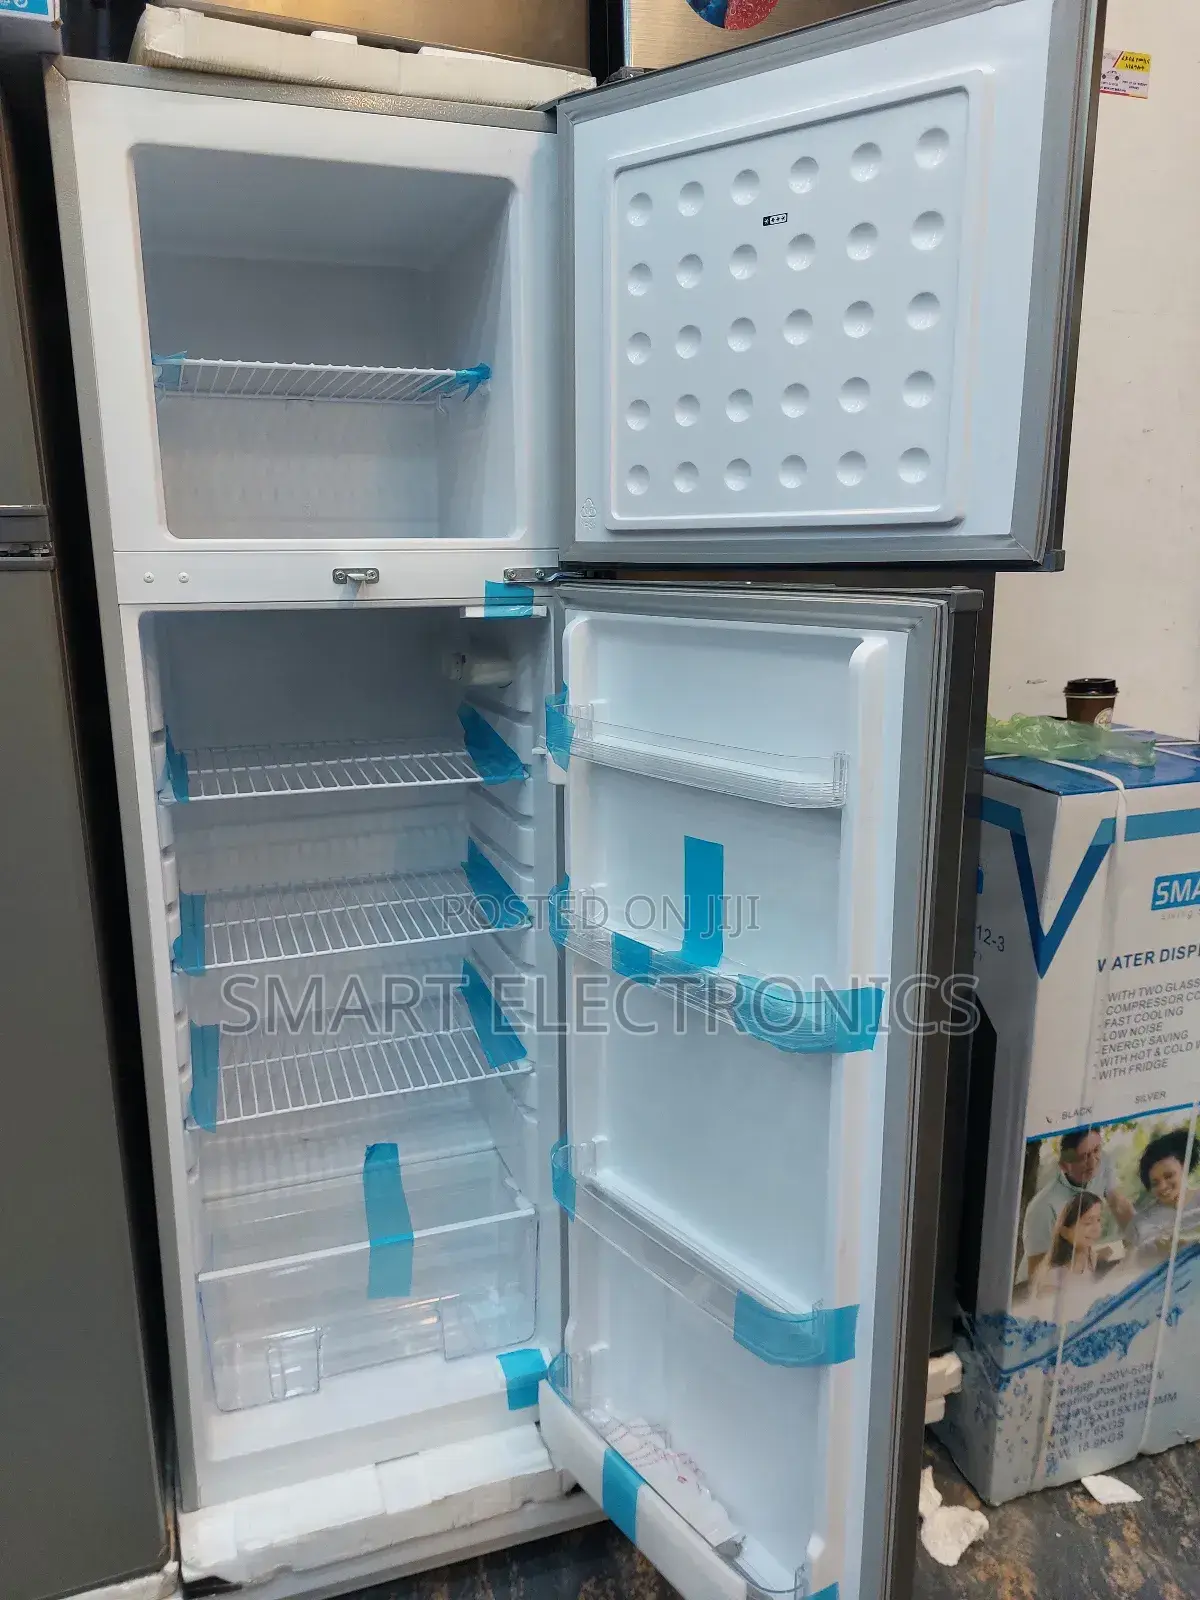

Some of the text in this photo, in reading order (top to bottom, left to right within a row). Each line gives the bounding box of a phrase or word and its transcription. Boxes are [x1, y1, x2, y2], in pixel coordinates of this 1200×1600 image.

[1159, 943, 1200, 963] DISP
[1138, 984, 1164, 997] TWO
[1105, 993, 1184, 1016] COMPRESSOR
[1103, 1006, 1184, 1029] FAST COOLING
[1101, 1038, 1148, 1056] ENERGY
[1148, 1029, 1189, 1046] SAVING
[1102, 1021, 1164, 1042] LOW NOISE
[1099, 1054, 1128, 1068] WITH
[1130, 1048, 1153, 1062] HOT
[1163, 1040, 1193, 1055] COLD
[1098, 1057, 1169, 1080] WITH FRIDGE
[1061, 1106, 1093, 1120] BLACK
